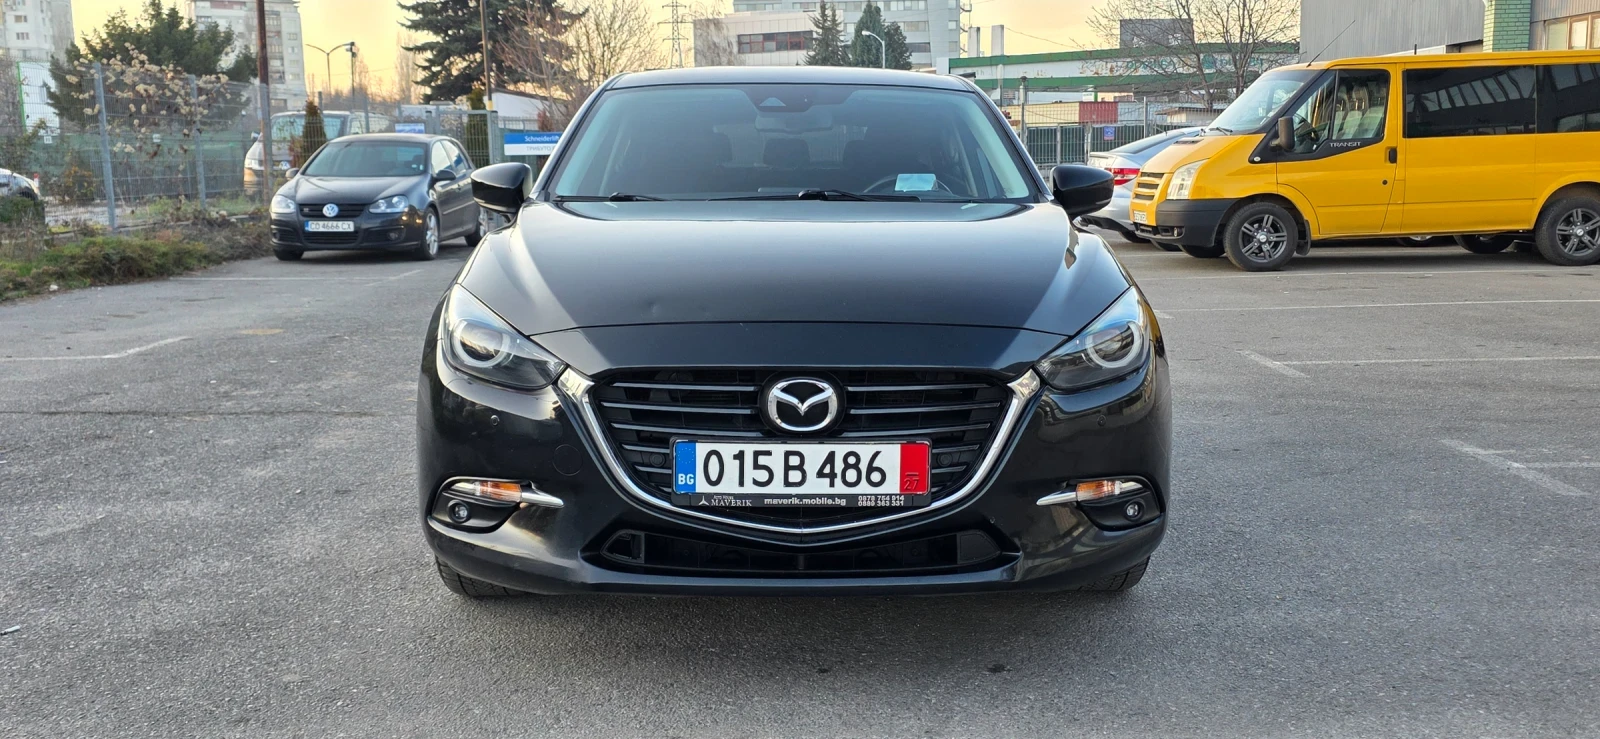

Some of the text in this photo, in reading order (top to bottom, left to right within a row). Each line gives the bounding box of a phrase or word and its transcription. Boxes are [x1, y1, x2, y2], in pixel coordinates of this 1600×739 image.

[677, 473, 695, 485] BG
[903, 477, 919, 490] 27
[711, 499, 752, 507] MAVERIK
[764, 497, 846, 506] maverik.mobile.bg
